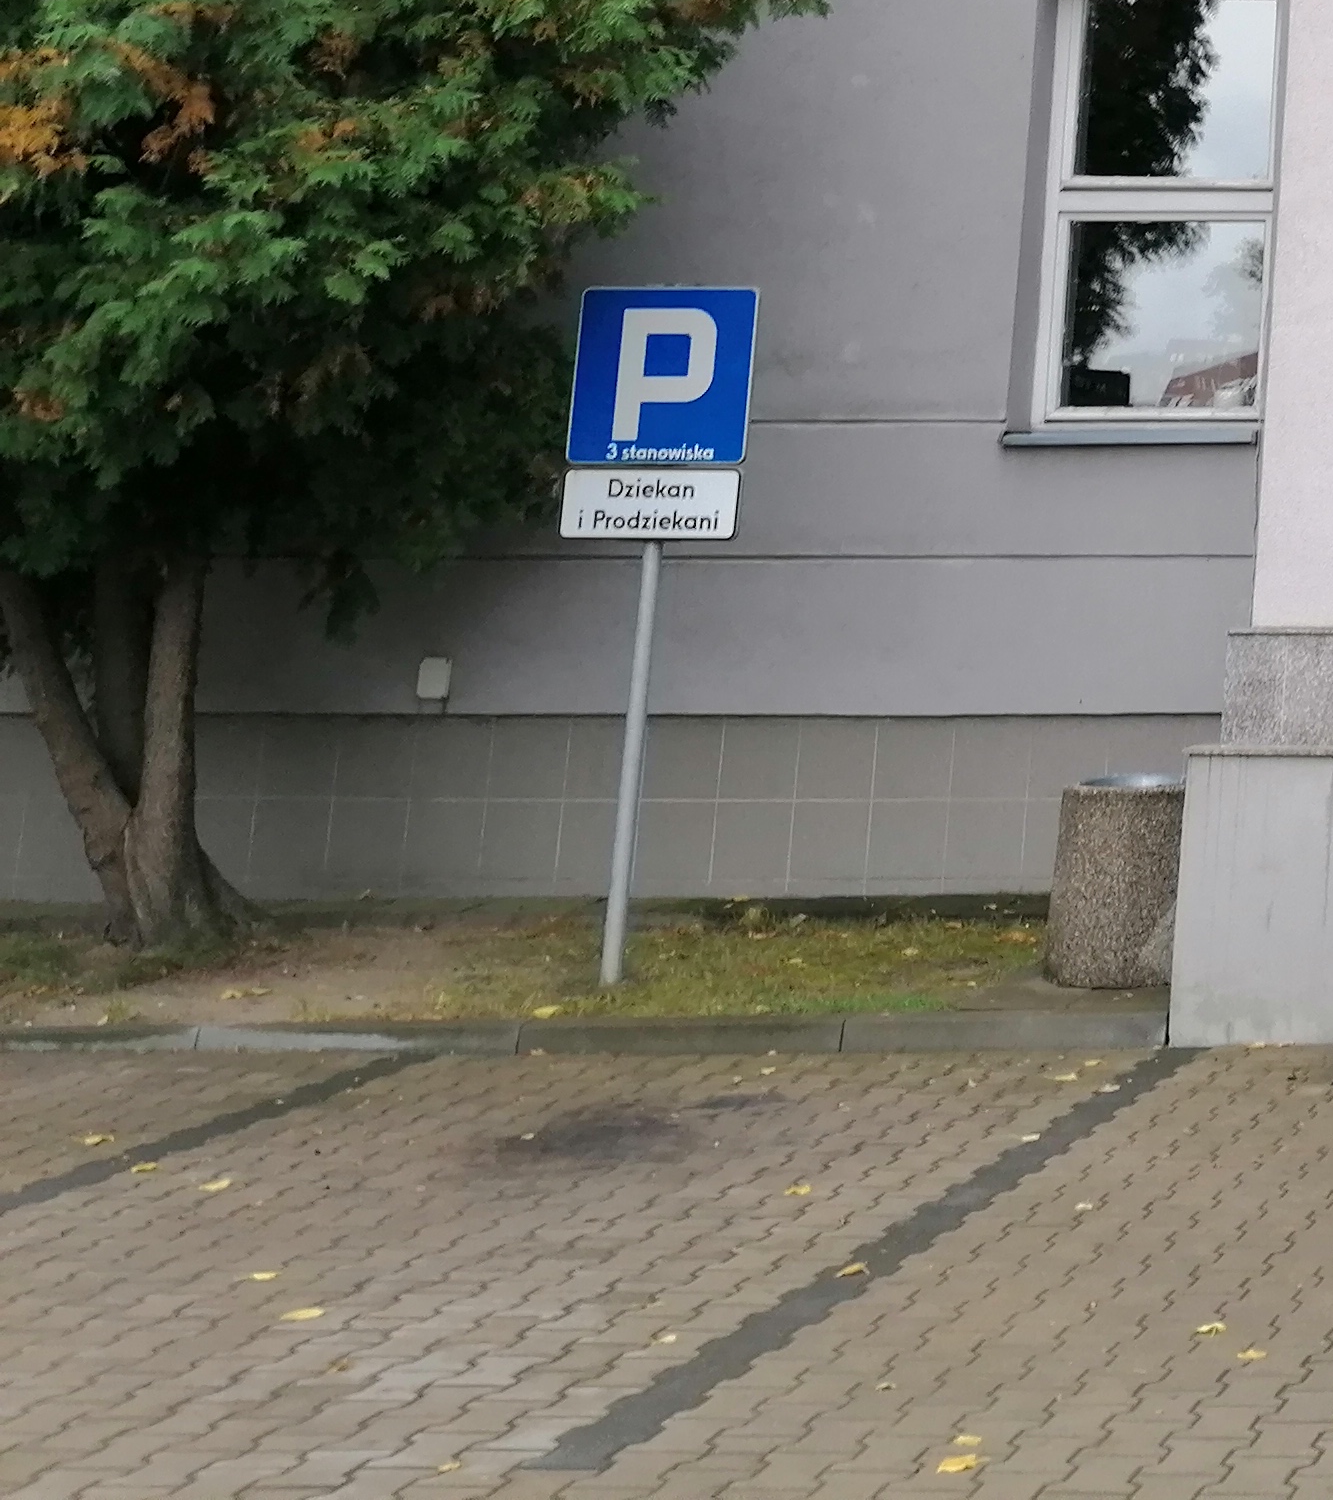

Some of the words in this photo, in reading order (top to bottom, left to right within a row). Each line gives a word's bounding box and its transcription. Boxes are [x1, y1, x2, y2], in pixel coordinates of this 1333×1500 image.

[611, 307, 718, 442] P
[605, 442, 618, 461] 3
[621, 443, 715, 461] stanowiska
[608, 478, 695, 499] Dziekan
[577, 509, 584, 530] i
[592, 509, 720, 531] Prodziekani
